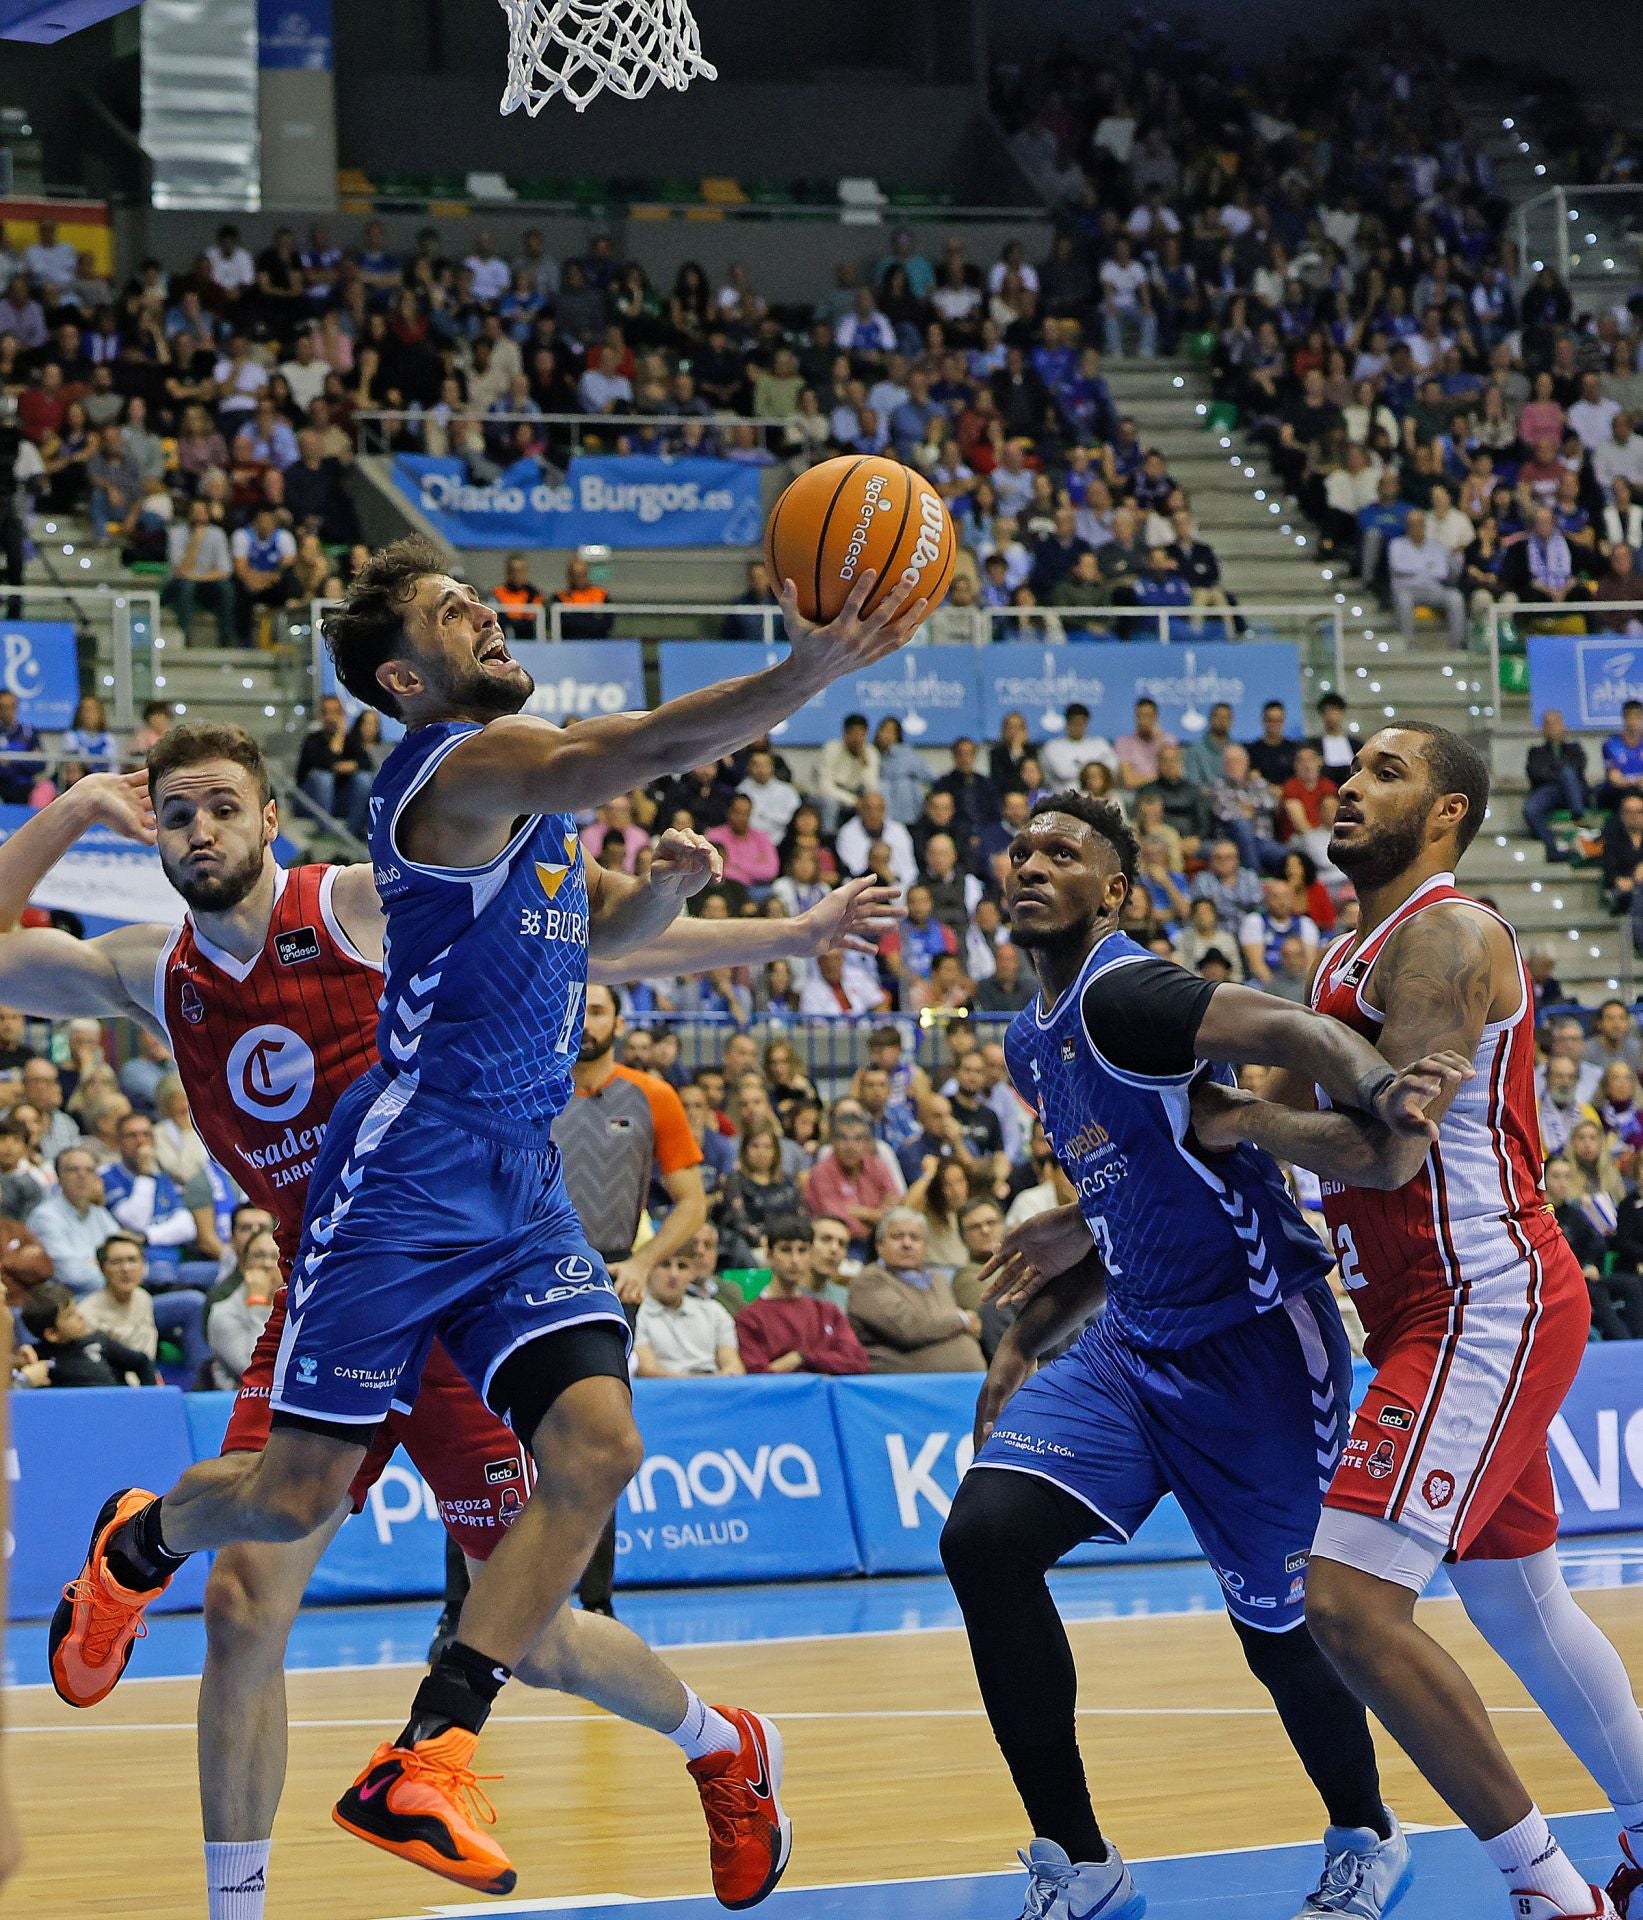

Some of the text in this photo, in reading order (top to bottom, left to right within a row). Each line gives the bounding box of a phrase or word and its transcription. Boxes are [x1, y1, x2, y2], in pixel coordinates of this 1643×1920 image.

[840, 474, 888, 581] liga endesa
[901, 492, 944, 586] Wilso
[529, 677, 627, 714] ntro
[279, 942, 297, 953] liga
[283, 946, 317, 961] endesa
[1085, 1215, 1123, 1276] 2
[1328, 1223, 1369, 1290] 2
[334, 1366, 386, 1380] CASTILLA
[241, 1386, 271, 1399] azu
[1381, 1414, 1403, 1426] acb
[992, 1430, 1032, 1444] CASTILLA
[1036, 1437, 1046, 1448] Y
[489, 1468, 513, 1481] acb
[637, 1527, 655, 1550] Y
[661, 1518, 749, 1549] SALUD
[1288, 1558, 1306, 1570] acb
